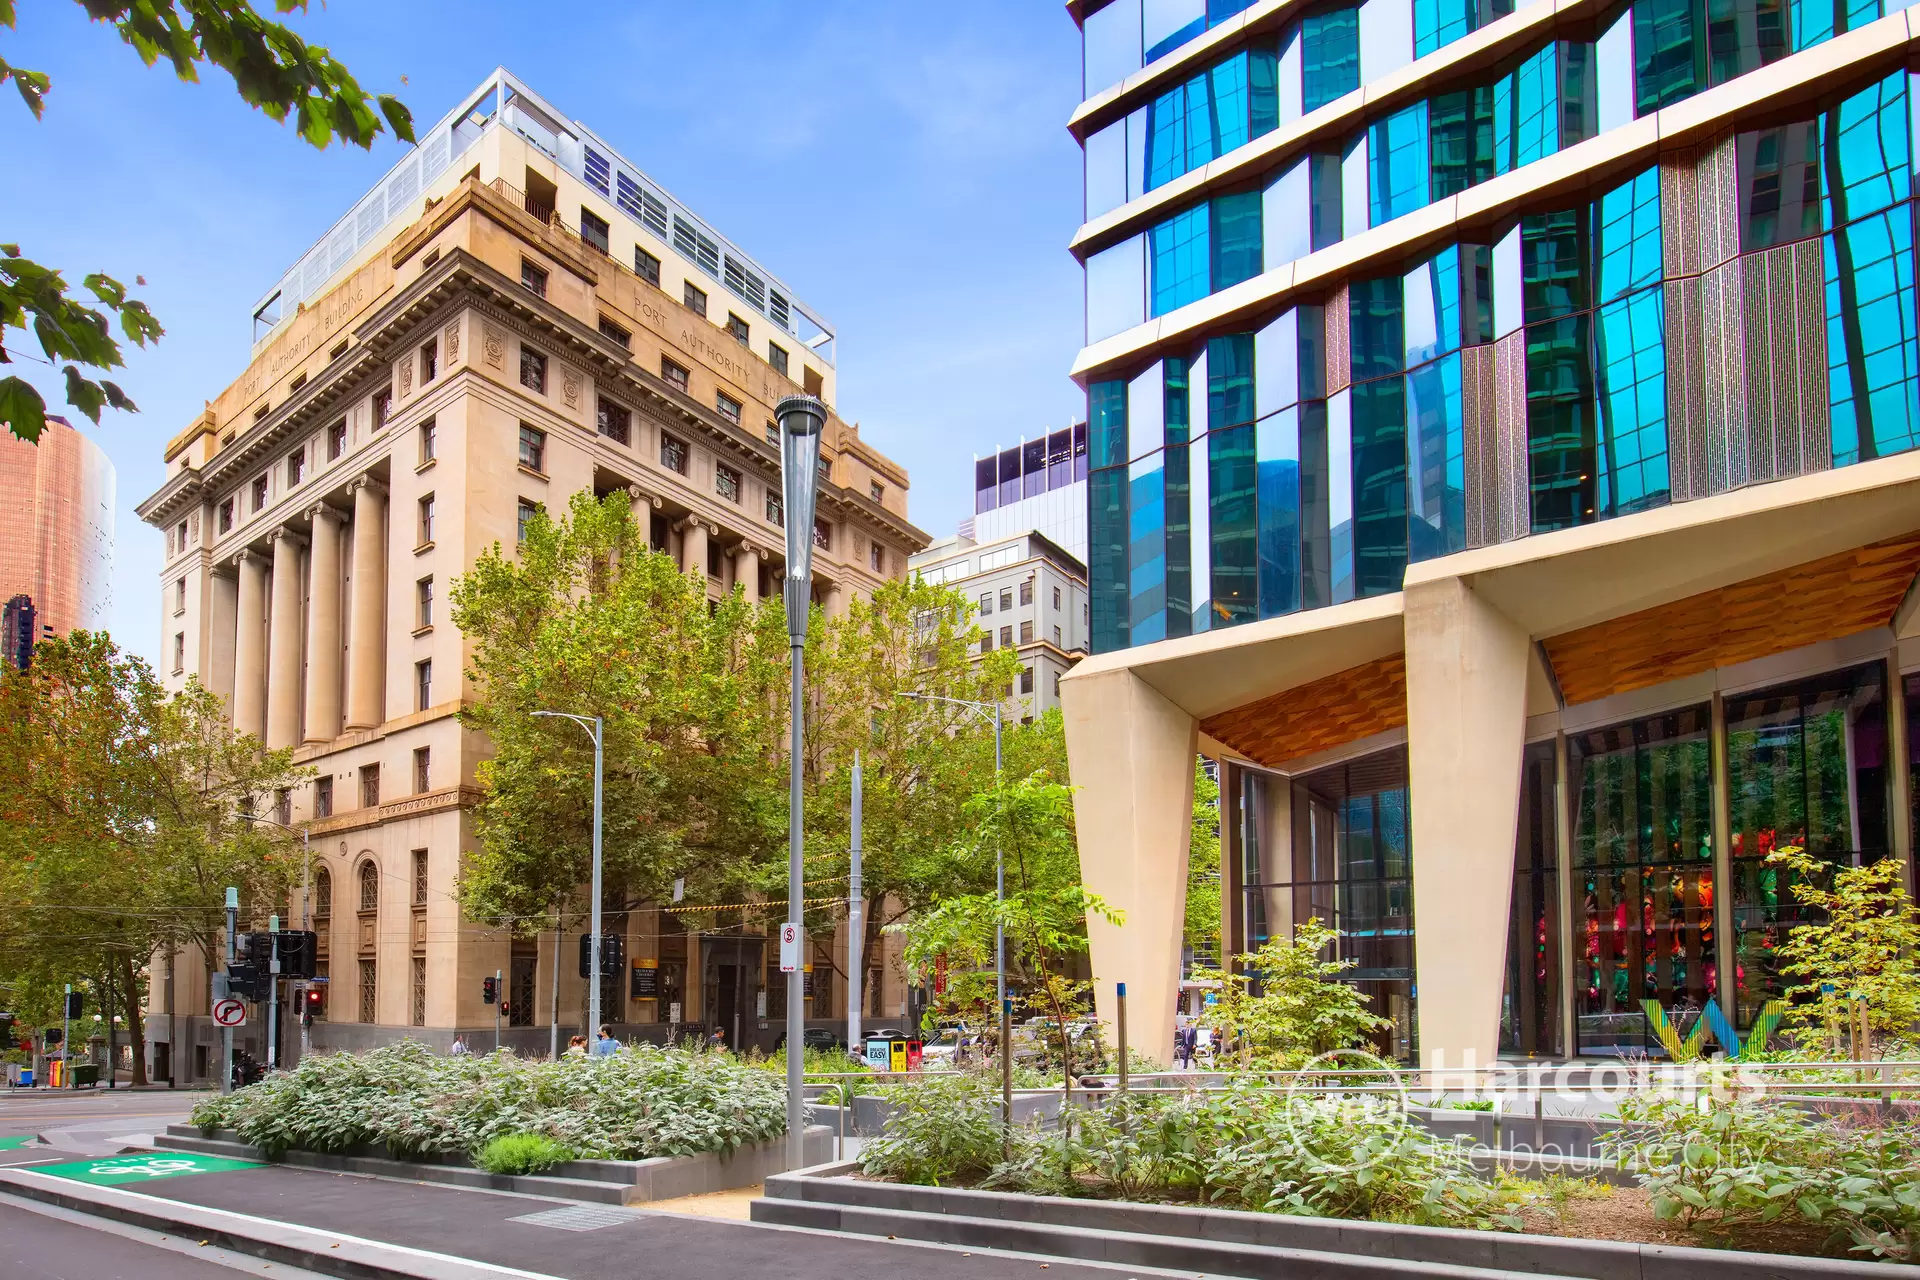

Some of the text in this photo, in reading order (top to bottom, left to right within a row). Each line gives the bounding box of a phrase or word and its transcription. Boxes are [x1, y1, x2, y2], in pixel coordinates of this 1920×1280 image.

[243, 288, 364, 398] PORT AUTHORITY BUILDING
[633, 297, 751, 384] PORT AUTHORITY
[869, 1051, 886, 1059] EASY
